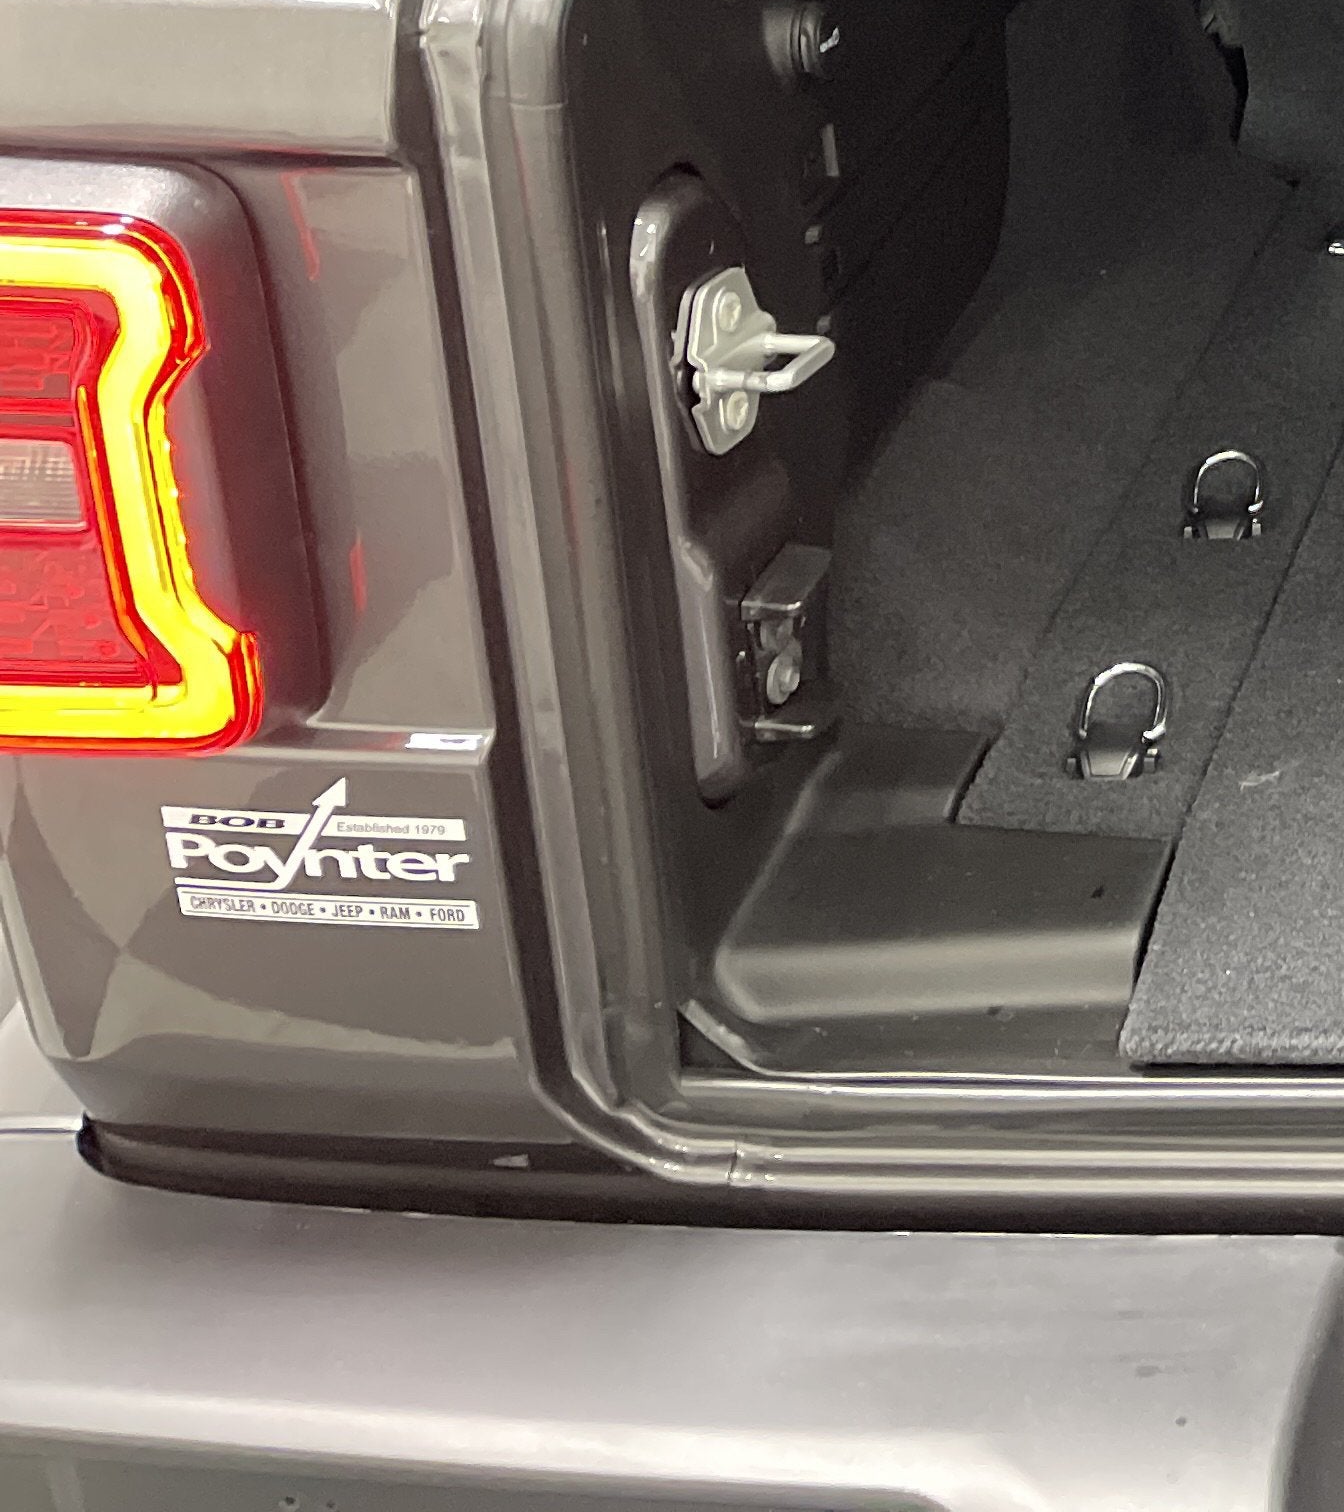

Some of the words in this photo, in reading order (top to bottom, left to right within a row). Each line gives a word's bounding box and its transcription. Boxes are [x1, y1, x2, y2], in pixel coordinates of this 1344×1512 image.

[189, 814, 286, 829] BOB
[336, 821, 410, 834] Established
[415, 824, 446, 835] 1979
[165, 831, 470, 884] Poynter
[190, 895, 256, 913] CHRYSLER
[271, 900, 316, 916] DODGE
[331, 904, 363, 918] JEEP
[379, 906, 412, 920] RAM
[430, 907, 465, 922] FORD
